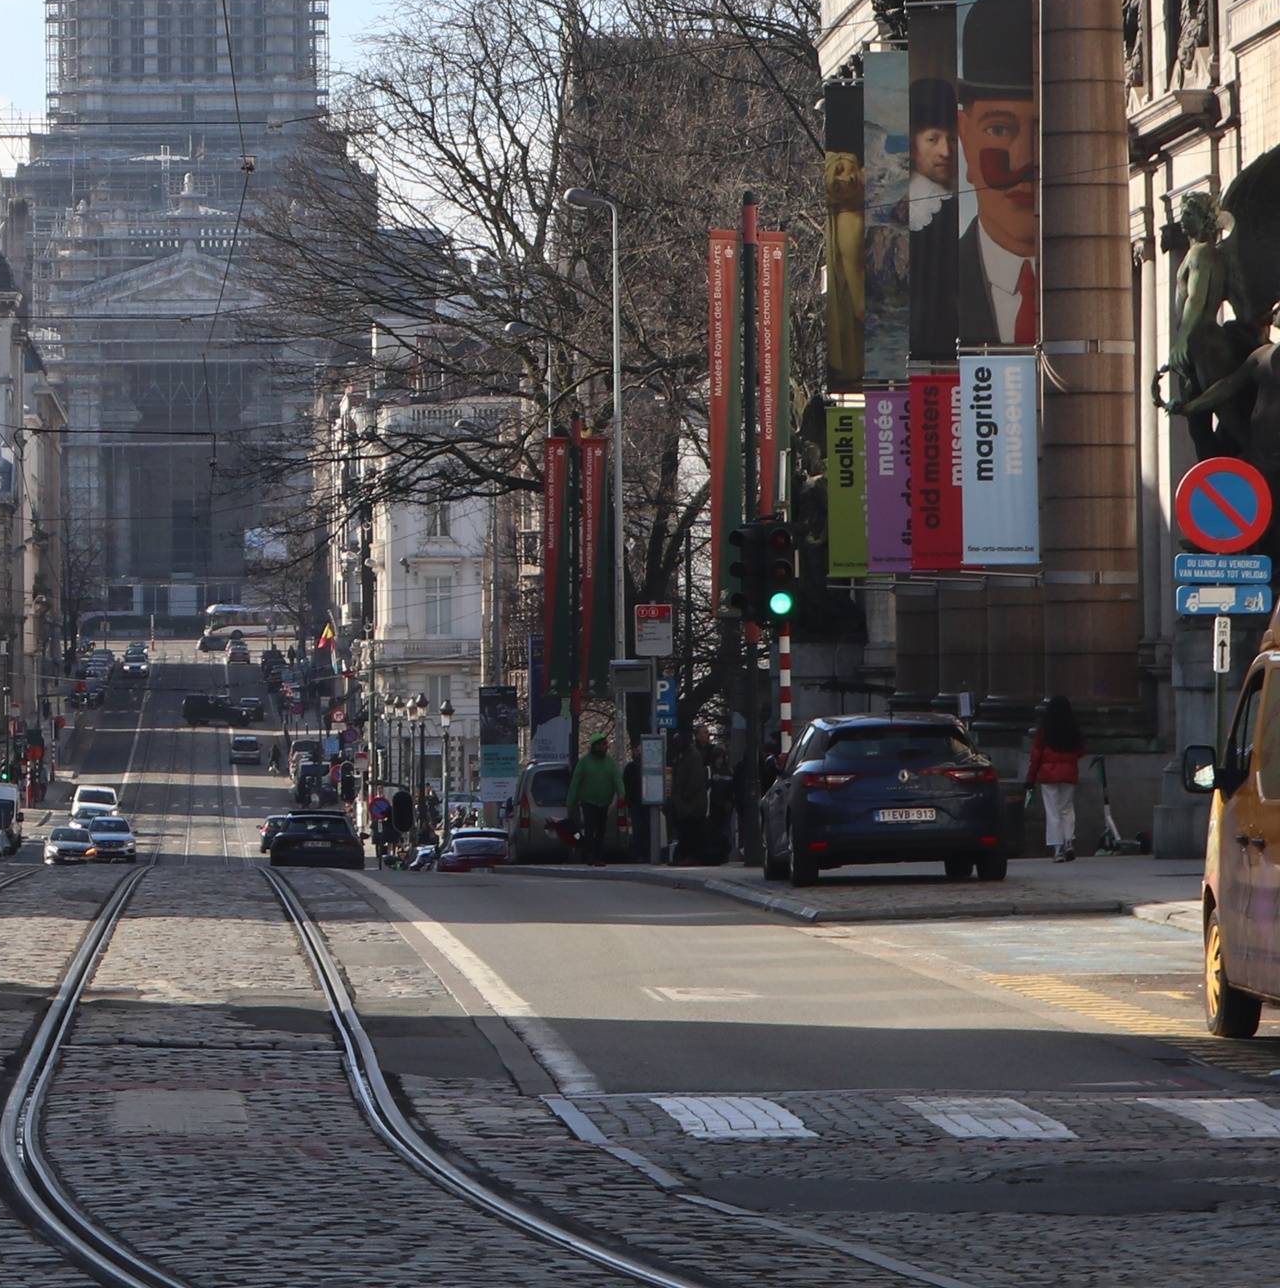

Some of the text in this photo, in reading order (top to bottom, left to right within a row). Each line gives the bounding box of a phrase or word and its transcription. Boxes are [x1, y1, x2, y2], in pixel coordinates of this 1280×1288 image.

[713, 244, 722, 299] Beaux-Arts
[762, 246, 771, 287] Kunsten
[713, 300, 722, 319] des
[763, 289, 771, 325] Schone
[714, 321, 722, 357] Royaux
[874, 399, 894, 477] musée
[970, 366, 998, 482] magritte
[1004, 365, 1023, 476] museum
[835, 415, 854, 488] walk in
[920, 385, 940, 530] old masters
[1179, 570, 1268, 580] VAN MAANDAG TOT VRIJDAG
[1187, 560, 1260, 569] DU LUNDI AU VENDREDI
[1219, 621, 1228, 629] 12
[656, 680, 670, 700] P
